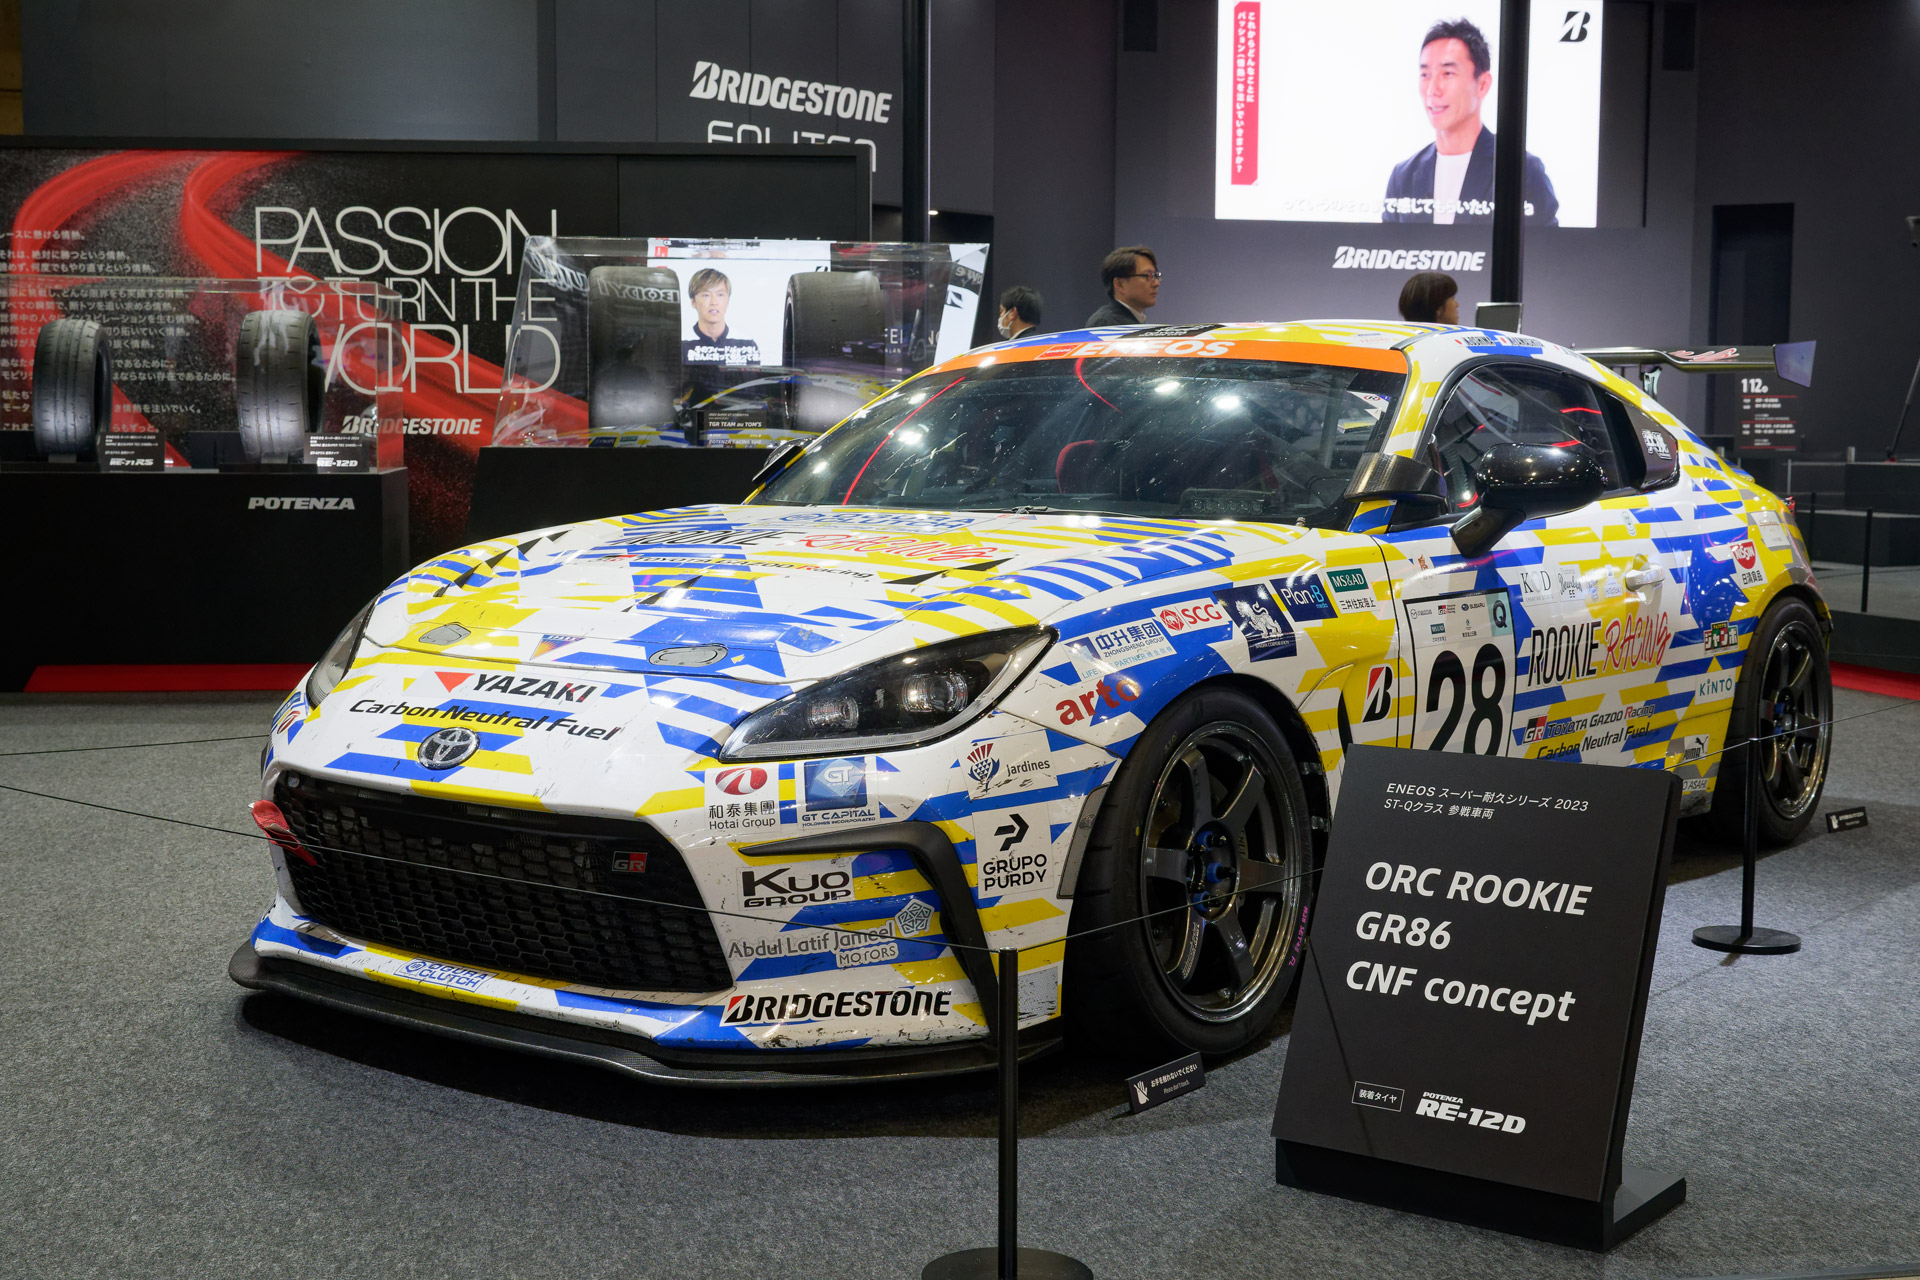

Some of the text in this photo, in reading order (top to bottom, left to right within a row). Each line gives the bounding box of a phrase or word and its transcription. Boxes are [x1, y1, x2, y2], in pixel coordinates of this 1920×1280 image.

[1246, 12, 1256, 103] これからどんなことに
[689, 60, 892, 124] BRIDGESTONE
[255, 206, 557, 276] PASSION
[1332, 245, 1486, 271] BRIDGESTONE
[461, 278, 558, 322] THE
[324, 322, 561, 396] ORLD
[1071, 339, 1236, 358] ENEOS
[342, 416, 482, 435] BRIDGESTONE
[248, 497, 355, 510] POTENZA
[1331, 573, 1365, 587] MS&AD
[1181, 603, 1222, 625] SCG
[1493, 600, 1507, 628] Q
[1095, 622, 1161, 650] 中升集团
[1528, 611, 1672, 687] ROOKIE RACING
[1103, 641, 1146, 658] ZHONGSHENG
[1114, 653, 1148, 668] PARTNER
[473, 674, 597, 702] YAZAKI
[1426, 643, 1506, 756] 28
[1055, 679, 1142, 725] arto
[349, 699, 622, 741] Carbon Neutral Fuel
[1525, 704, 1656, 743] GR TOYOTA GAZOO Racing
[1581, 730, 1626, 752] Neutral
[1626, 722, 1651, 738] Fuel
[709, 799, 775, 820] 和泰集團
[1384, 798, 1495, 819] ST-Qクラス 参戦車両
[1386, 783, 1589, 812] ENEOS スーパー耐久シリーズ 2023
[709, 817, 776, 830] Hotai Group
[802, 808, 876, 823] GT CAPITAL
[831, 816, 876, 825] INCORPORATED
[614, 859, 644, 871] GR
[983, 853, 1048, 875] GRUPO
[984, 868, 1048, 891] PURDY
[1365, 861, 1593, 916] ORC ROOKIE
[744, 889, 852, 908] GROUP
[728, 922, 894, 959] Abdul Latif Jameel
[1356, 911, 1452, 950] GR86
[839, 945, 897, 966] MOTORS
[419, 968, 480, 988] CLUTCH
[428, 963, 489, 980] OGURA
[1346, 960, 1576, 1026] CNF concept
[724, 990, 951, 1023] BRIDGESTONE
[1359, 1089, 1398, 1104] 装着タイヤ
[1422, 1091, 1464, 1104] POTENZA
[1415, 1098, 1526, 1134] RE-12D
